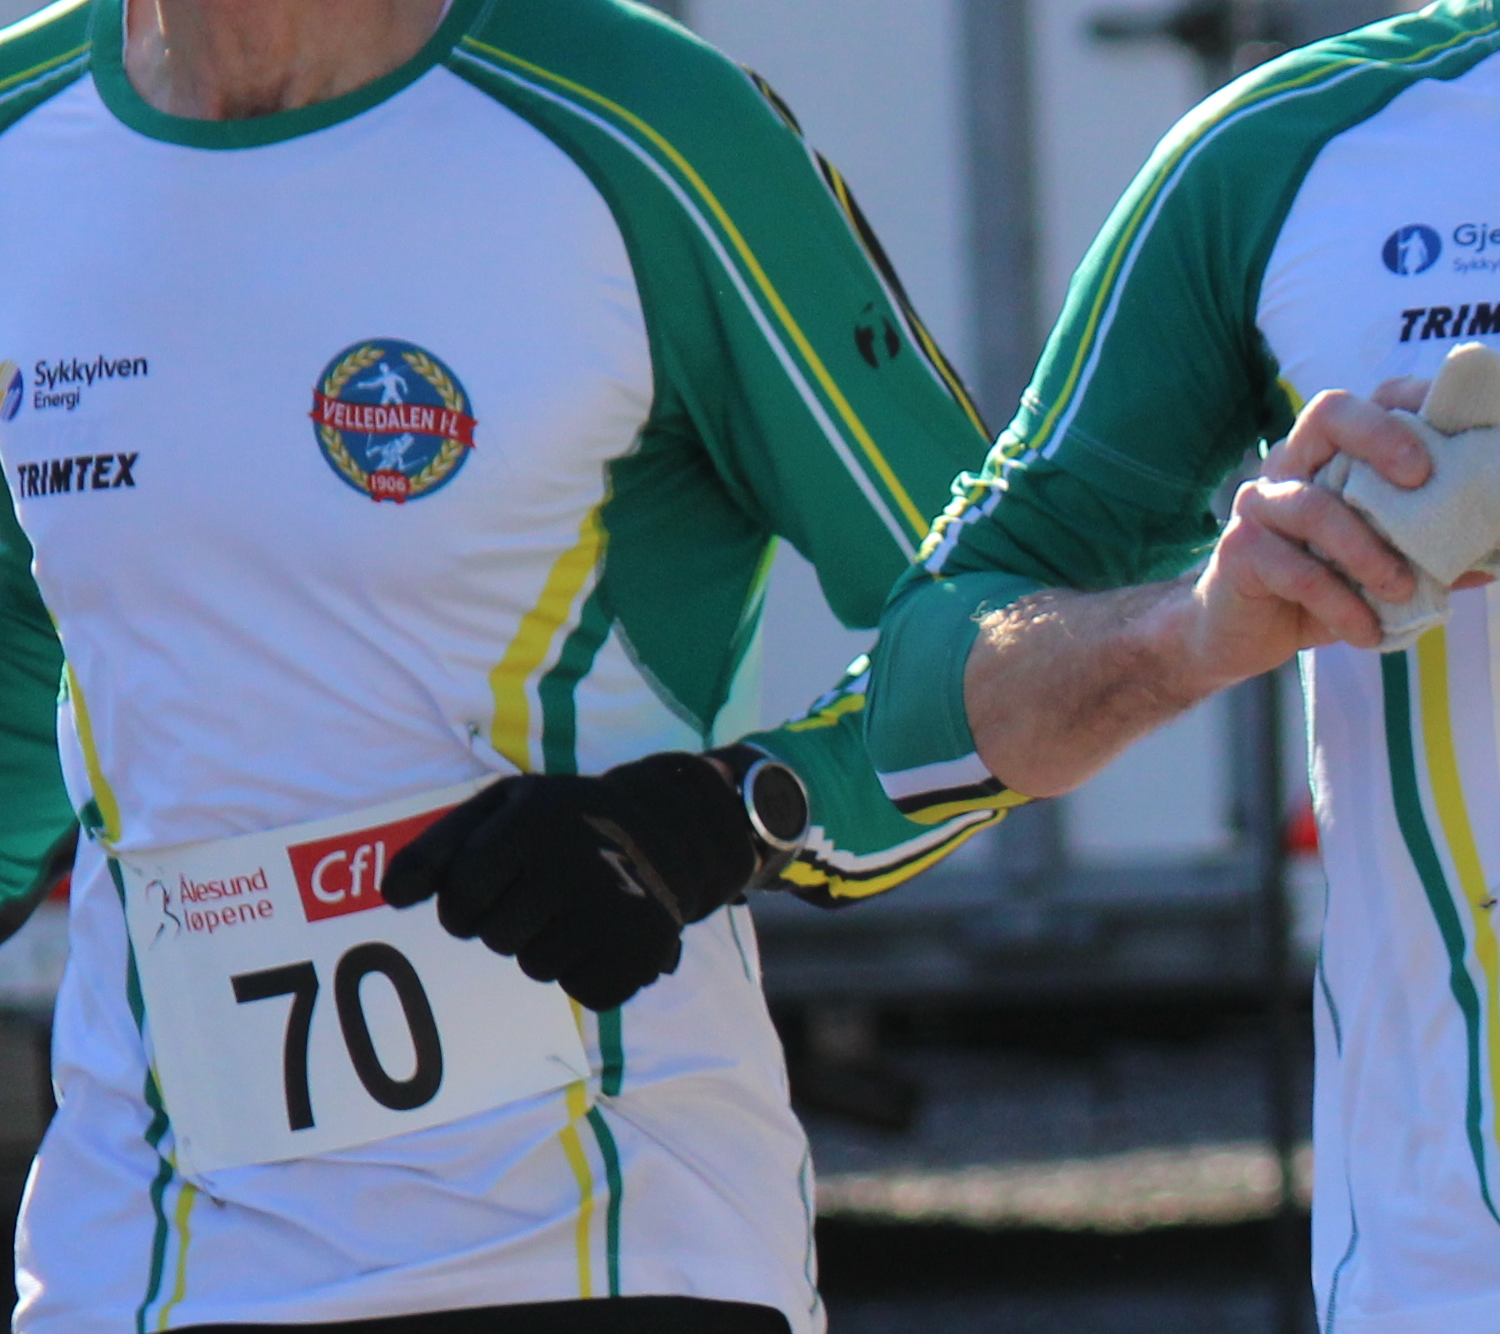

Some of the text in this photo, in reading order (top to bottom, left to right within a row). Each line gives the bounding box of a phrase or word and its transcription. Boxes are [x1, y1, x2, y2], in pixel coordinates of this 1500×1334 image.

[33, 354, 148, 389] Sykkylven
[33, 388, 81, 413] Energi
[322, 400, 435, 430] VELLEDALEN
[17, 452, 139, 498] TRIMTEX
[371, 475, 407, 491] 1906
[179, 867, 269, 905] Ålesund
[310, 841, 386, 904] Cfl
[183, 898, 274, 934] løpene
[230, 941, 444, 1131] 70
